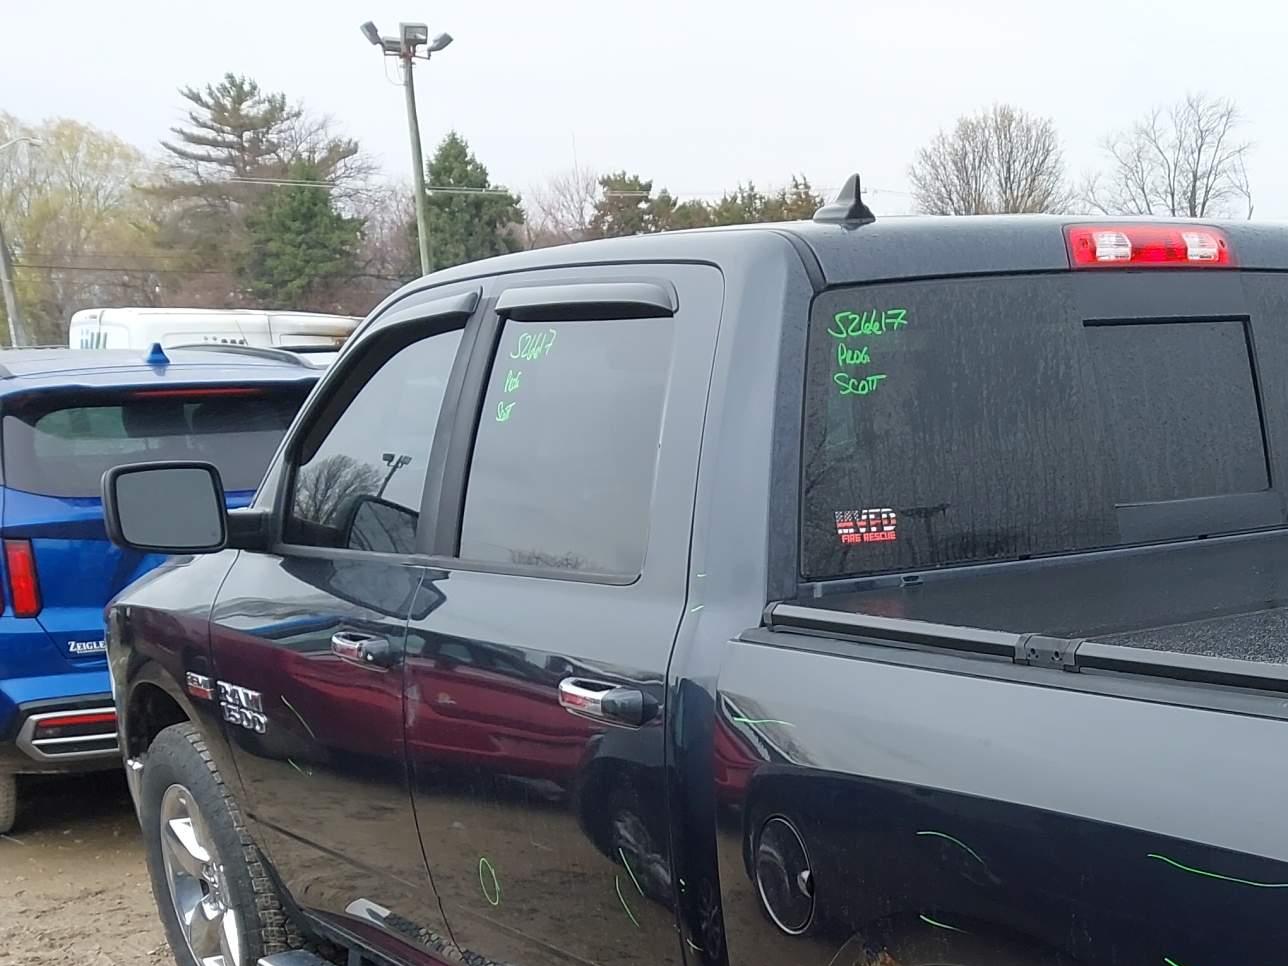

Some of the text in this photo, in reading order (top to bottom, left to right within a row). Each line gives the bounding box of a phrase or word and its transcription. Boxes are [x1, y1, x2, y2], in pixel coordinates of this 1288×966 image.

[67, 640, 107, 652] ZEIGLE
[217, 680, 263, 713] RAM
[220, 701, 267, 734] 1500
